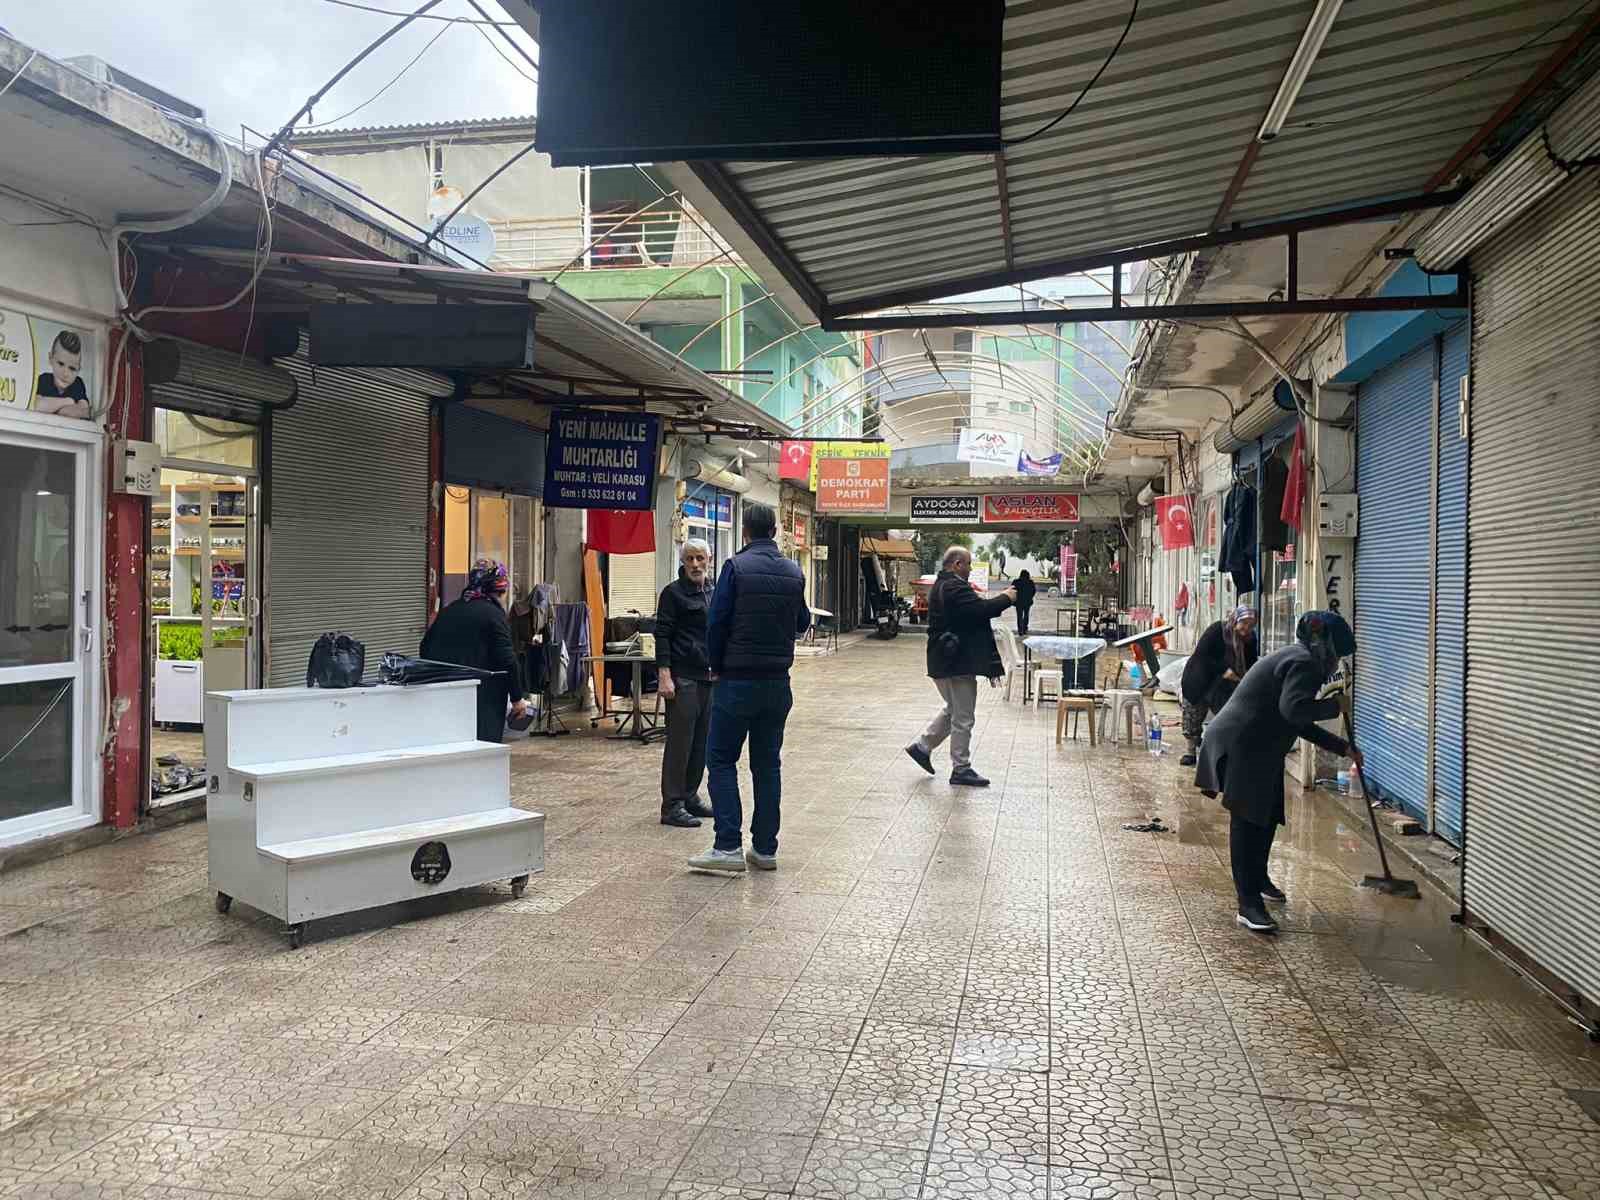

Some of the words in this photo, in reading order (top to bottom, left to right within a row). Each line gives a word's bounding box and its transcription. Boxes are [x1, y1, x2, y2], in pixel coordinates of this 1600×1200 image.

[558, 418, 586, 439] YENİ
[590, 422, 646, 442] MAHALLE
[562, 446, 637, 468] MUHTARLIĞI
[554, 470, 586, 483] MUHTAR
[592, 470, 610, 485] VELİ
[612, 473, 645, 486] KARASU
[820, 478, 886, 488] DEMOKRAT
[836, 489, 870, 499] PARTİ
[914, 497, 976, 509] AYDOĞAN
[997, 496, 1056, 506] ASLAN
